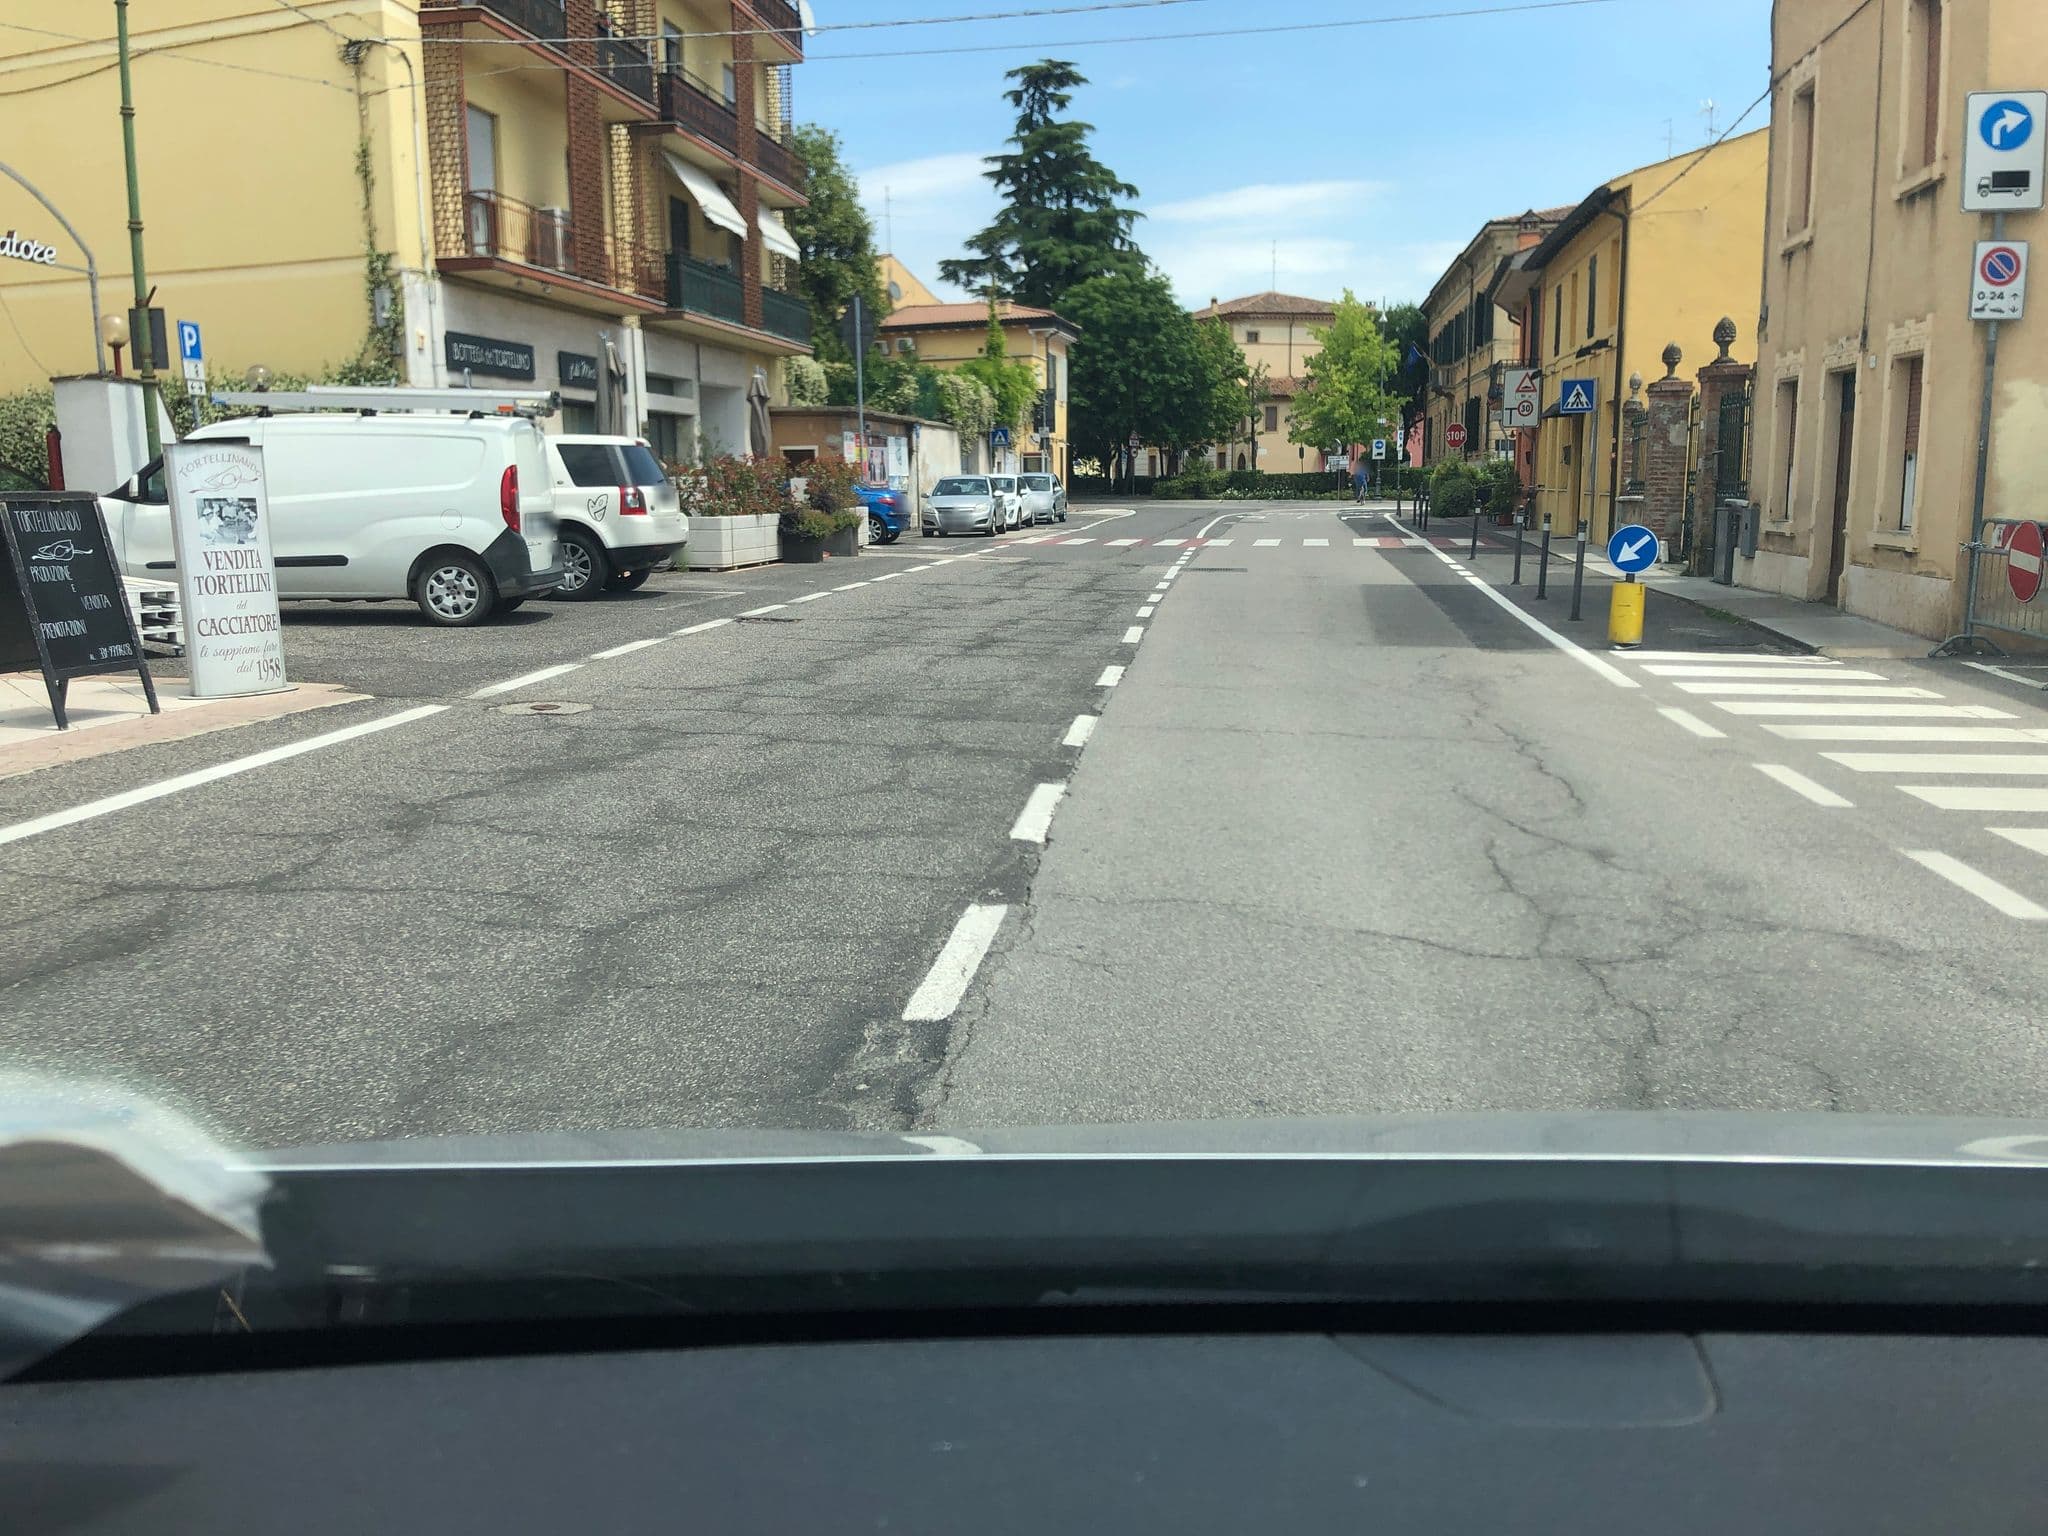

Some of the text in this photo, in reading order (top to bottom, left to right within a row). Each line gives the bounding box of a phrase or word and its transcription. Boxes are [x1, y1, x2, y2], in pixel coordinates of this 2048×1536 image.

[183, 325, 197, 357] P
[1446, 431, 1466, 441] STOP
[203, 549, 262, 571] VENDITA
[30, 565, 73, 583] PRODUZIONE
[194, 572, 271, 595] TORTELLINI
[71, 584, 77, 593] E
[80, 594, 112, 611] VENDITA
[40, 619, 87, 640] PRENOTAZIONI
[197, 613, 278, 637] CACCIATORE
[236, 657, 281, 682] dal 1958
